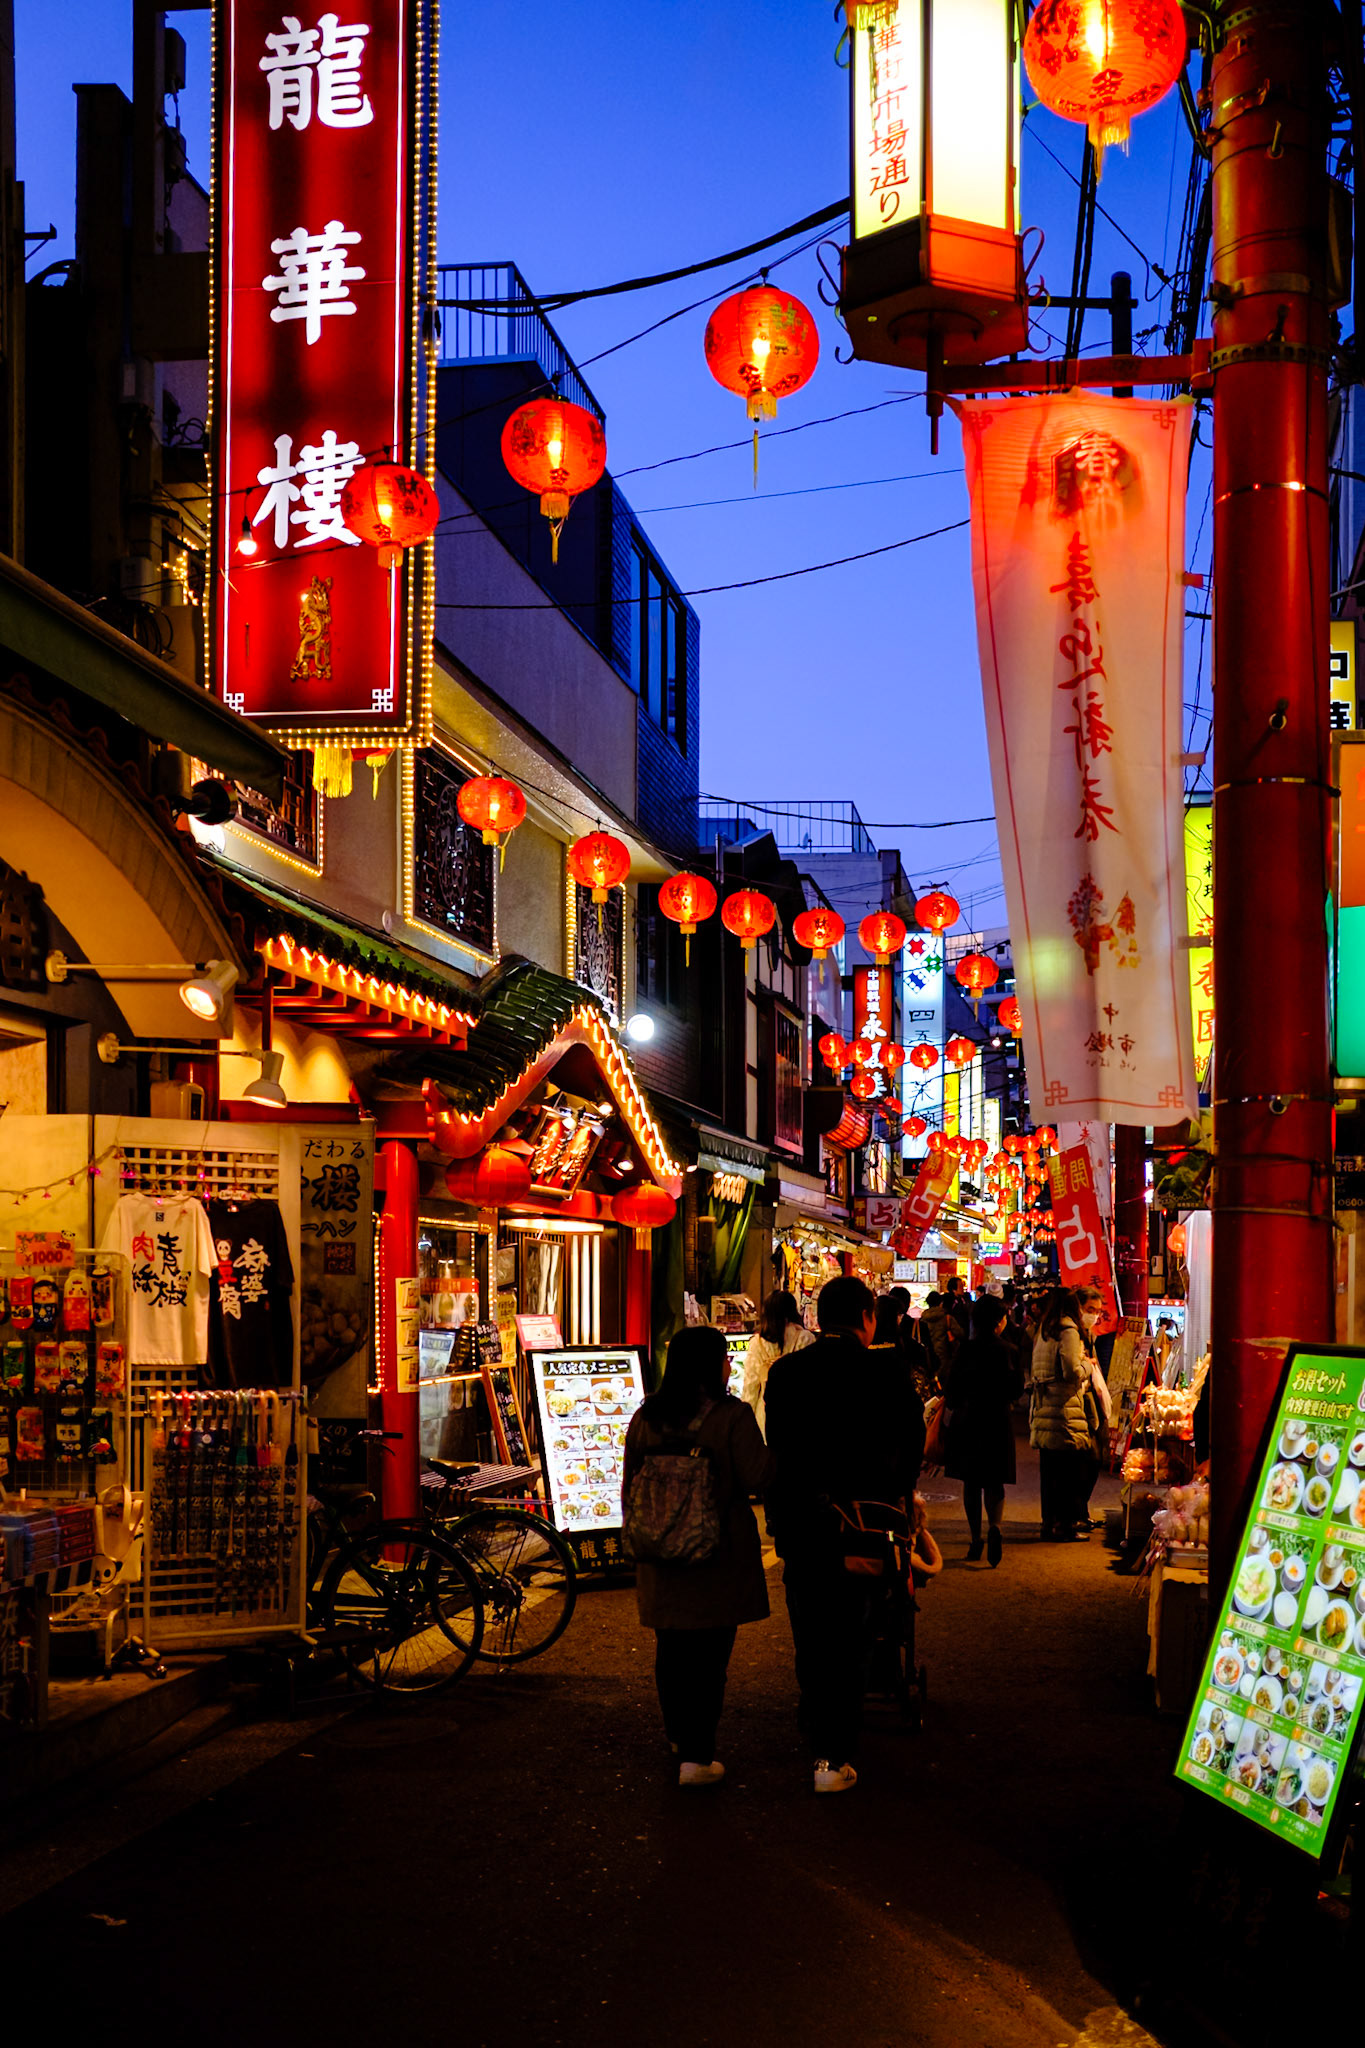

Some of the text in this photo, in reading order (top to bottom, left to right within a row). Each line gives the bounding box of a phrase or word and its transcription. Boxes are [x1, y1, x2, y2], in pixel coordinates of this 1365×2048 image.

[871, 1202, 896, 1228] 占
[548, 1361, 628, 1375] 人気定食メニュー
[1292, 1367, 1347, 1395] お得セット
